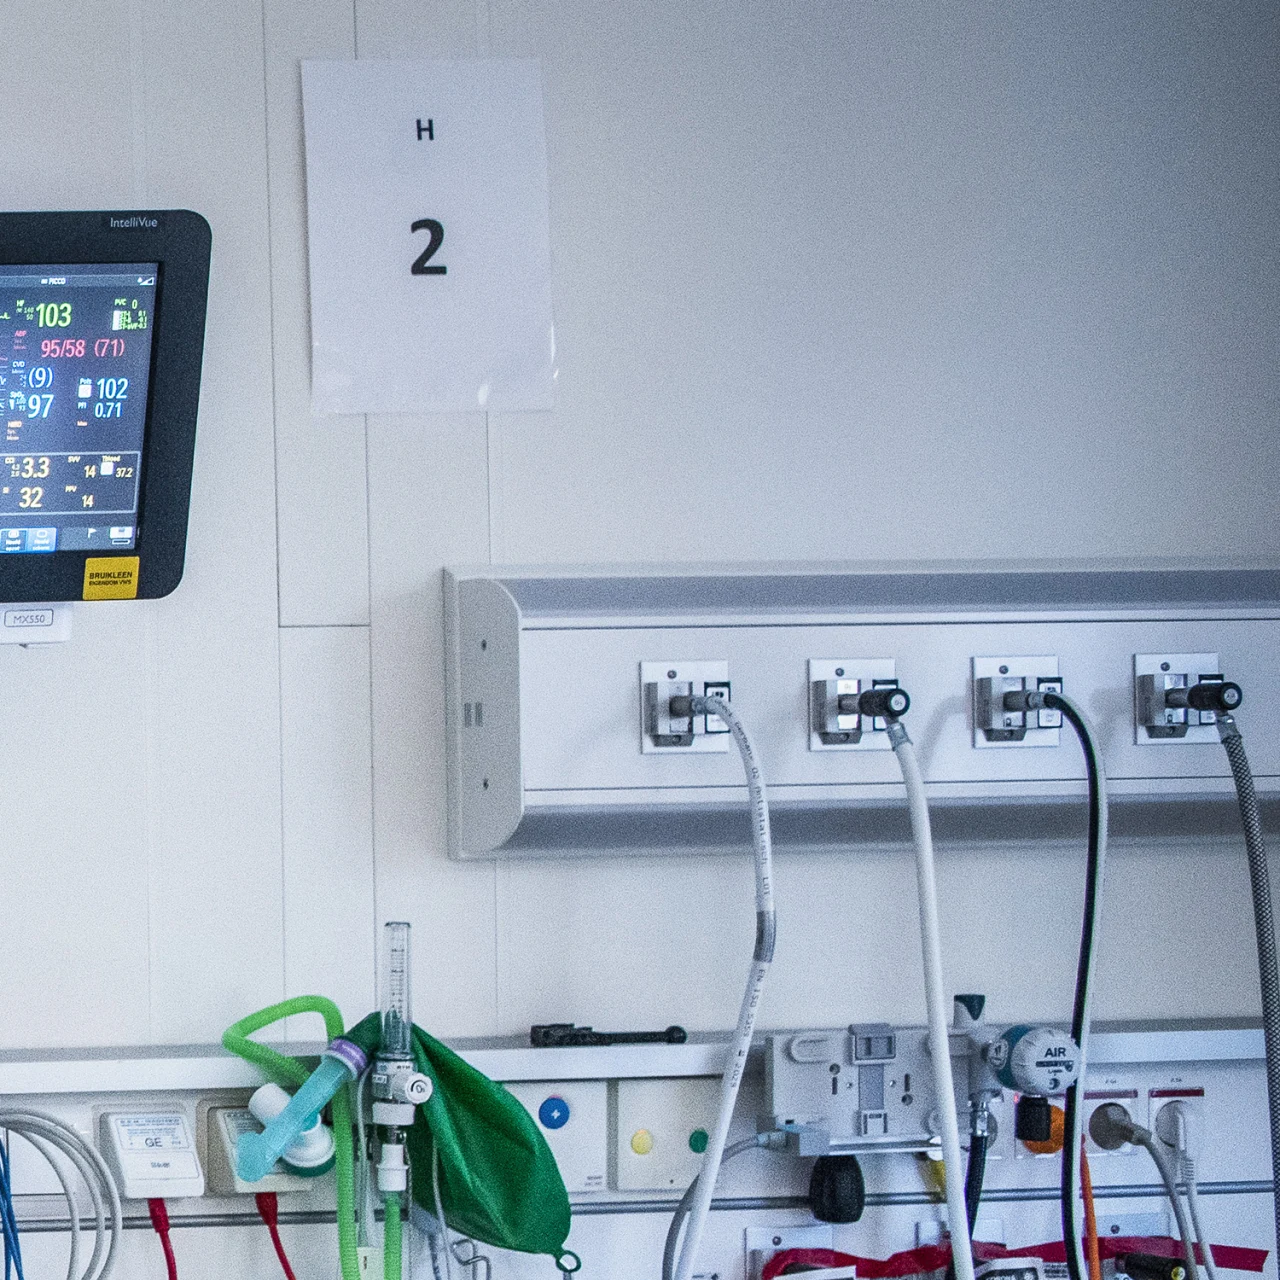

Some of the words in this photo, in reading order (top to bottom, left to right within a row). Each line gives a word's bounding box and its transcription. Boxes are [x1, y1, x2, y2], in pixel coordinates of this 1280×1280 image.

[416, 118, 434, 141] H
[109, 216, 159, 229] IntelliVue
[410, 218, 448, 276] 2
[131, 299, 138, 309] 0
[35, 302, 72, 328] 103
[41, 339, 86, 358] 95/58
[94, 338, 125, 357] (71)
[28, 367, 54, 389] (9)
[96, 378, 129, 399] 102
[28, 394, 55, 419] 97
[94, 402, 122, 418] 0.71
[21, 457, 50, 479] 3.3
[84, 465, 97, 478] 14
[115, 467, 133, 478] 37.2
[18, 486, 43, 508] 32
[81, 495, 94, 508] 14
[89, 571, 133, 580] BRUIKLEEN
[13, 614, 46, 625] MX550
[1044, 1047, 1067, 1059] AIR
[144, 1136, 163, 1148] GE
